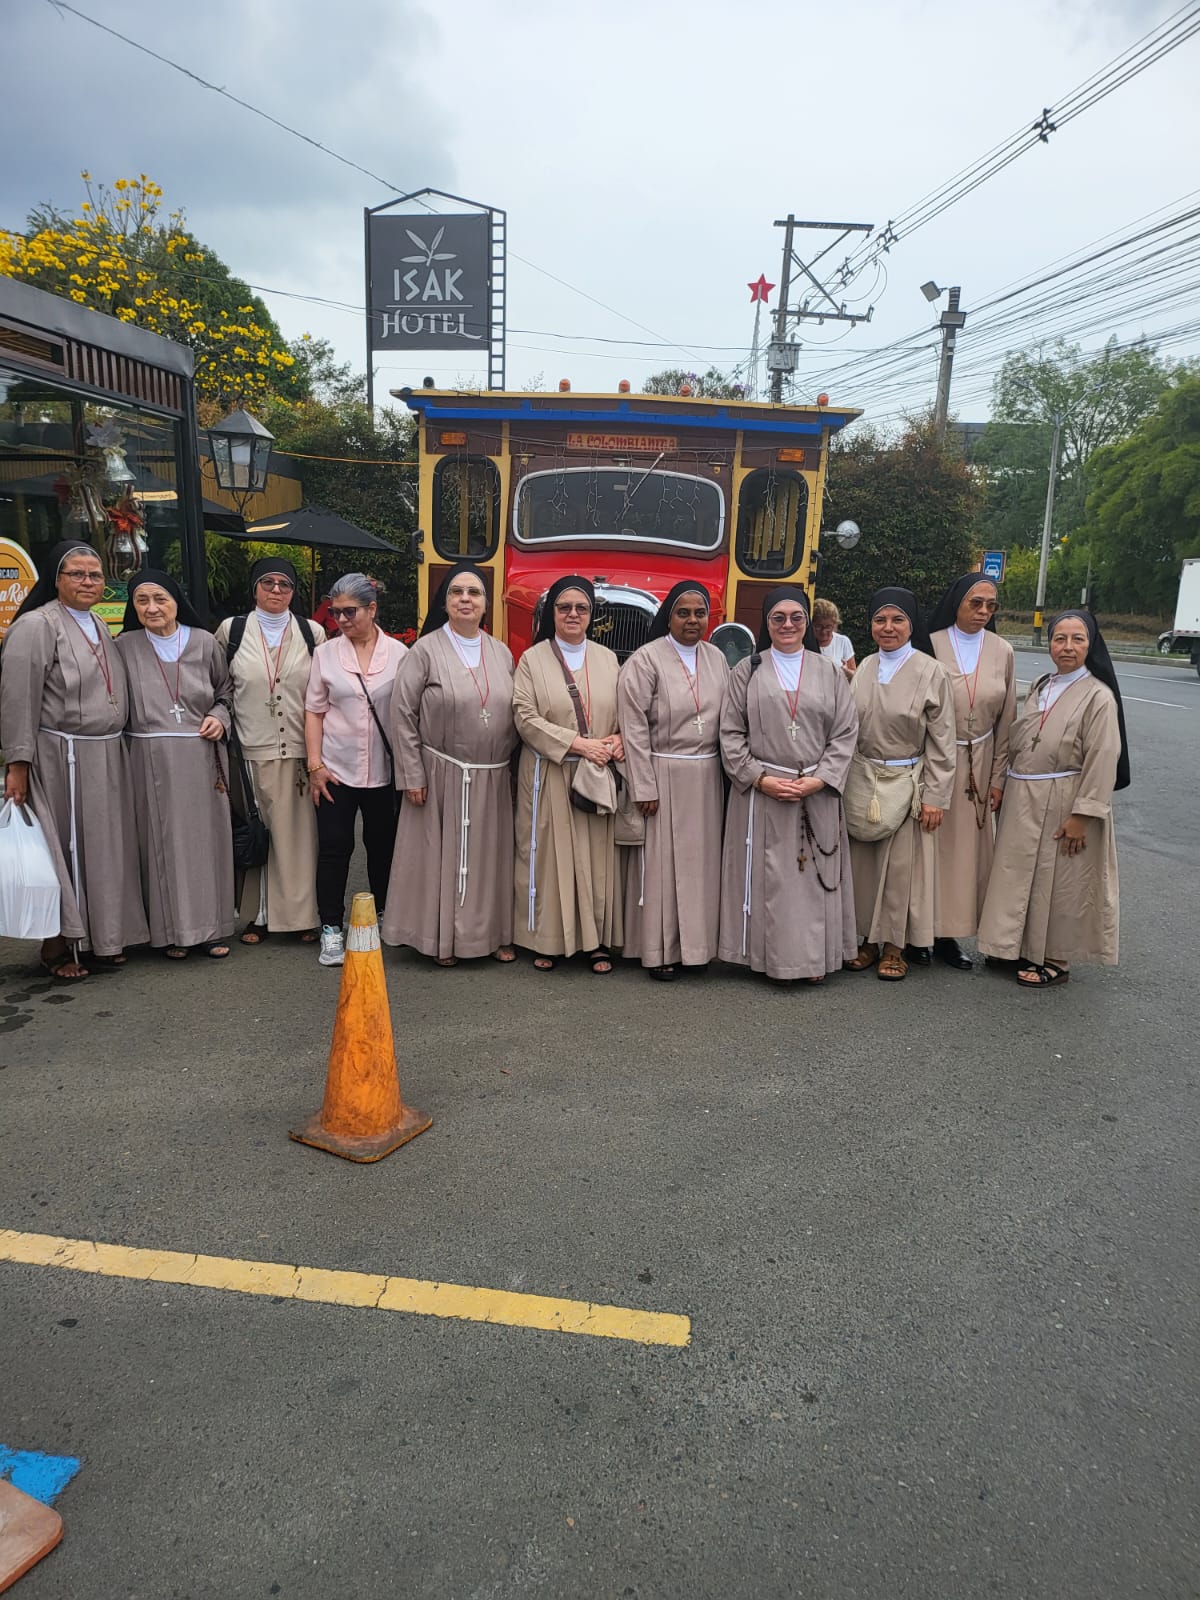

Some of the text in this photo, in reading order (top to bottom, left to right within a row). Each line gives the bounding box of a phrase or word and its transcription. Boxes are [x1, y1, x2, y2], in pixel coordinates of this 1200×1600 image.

[393, 268, 464, 301] ISAK
[381, 309, 482, 340] HOTEL
[568, 434, 583, 447] LA
